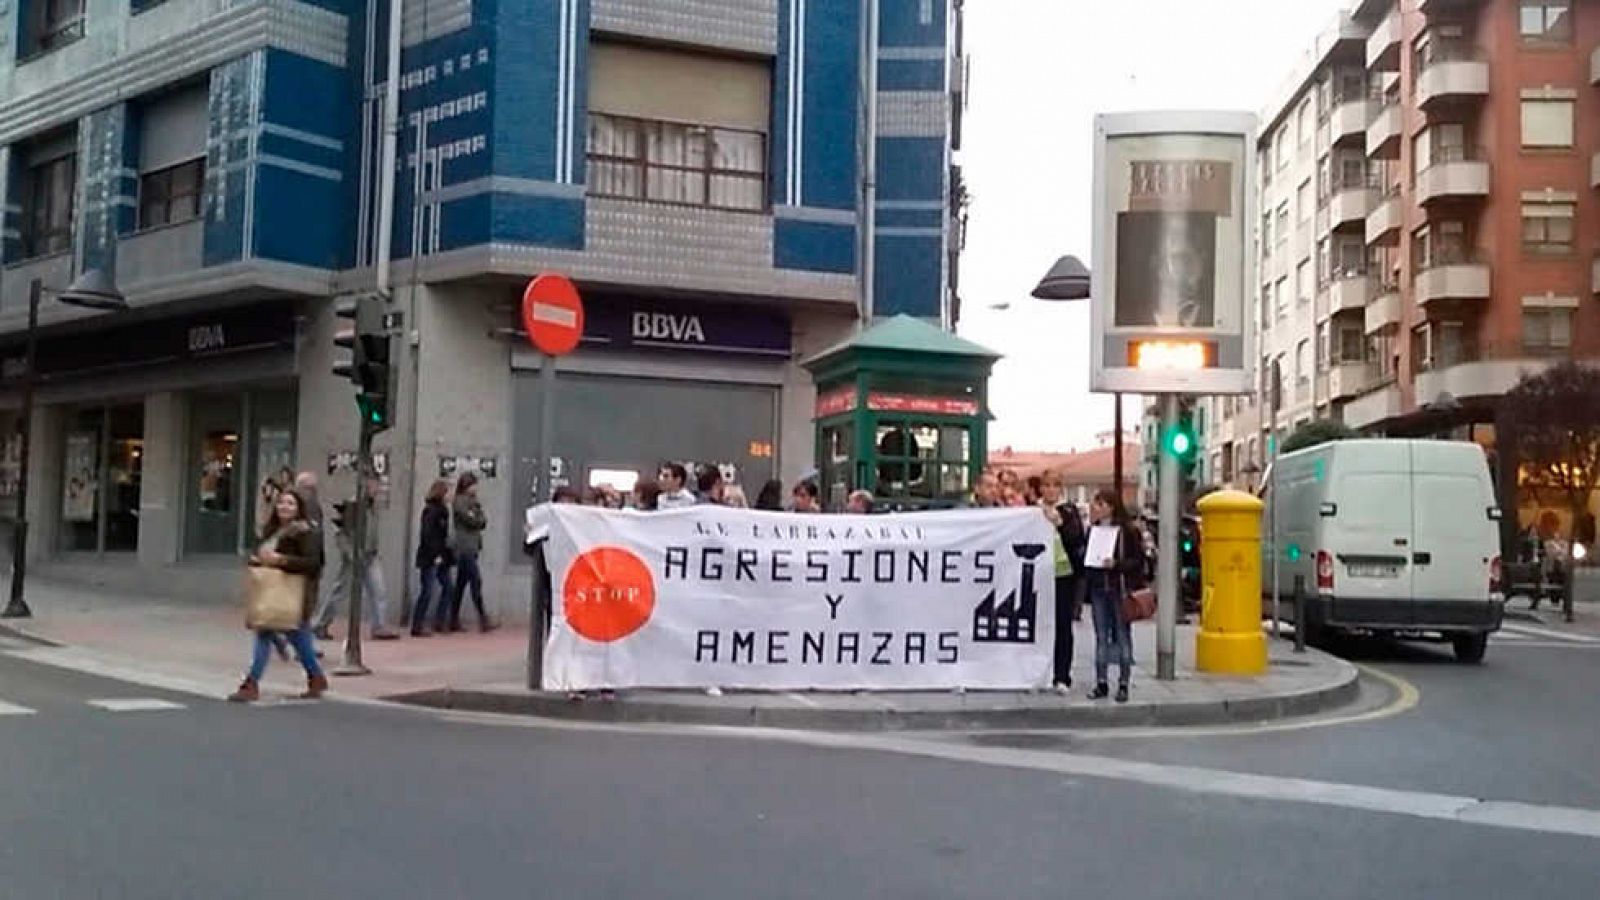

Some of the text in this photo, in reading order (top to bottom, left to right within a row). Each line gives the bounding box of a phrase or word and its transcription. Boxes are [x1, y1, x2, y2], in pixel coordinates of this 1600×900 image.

[632, 311, 706, 342] BBVA
[664, 546, 996, 584] AGRESIONES
[575, 587, 641, 603] STOP
[825, 593, 845, 620] Y
[695, 630, 961, 665] AMENAZAS
